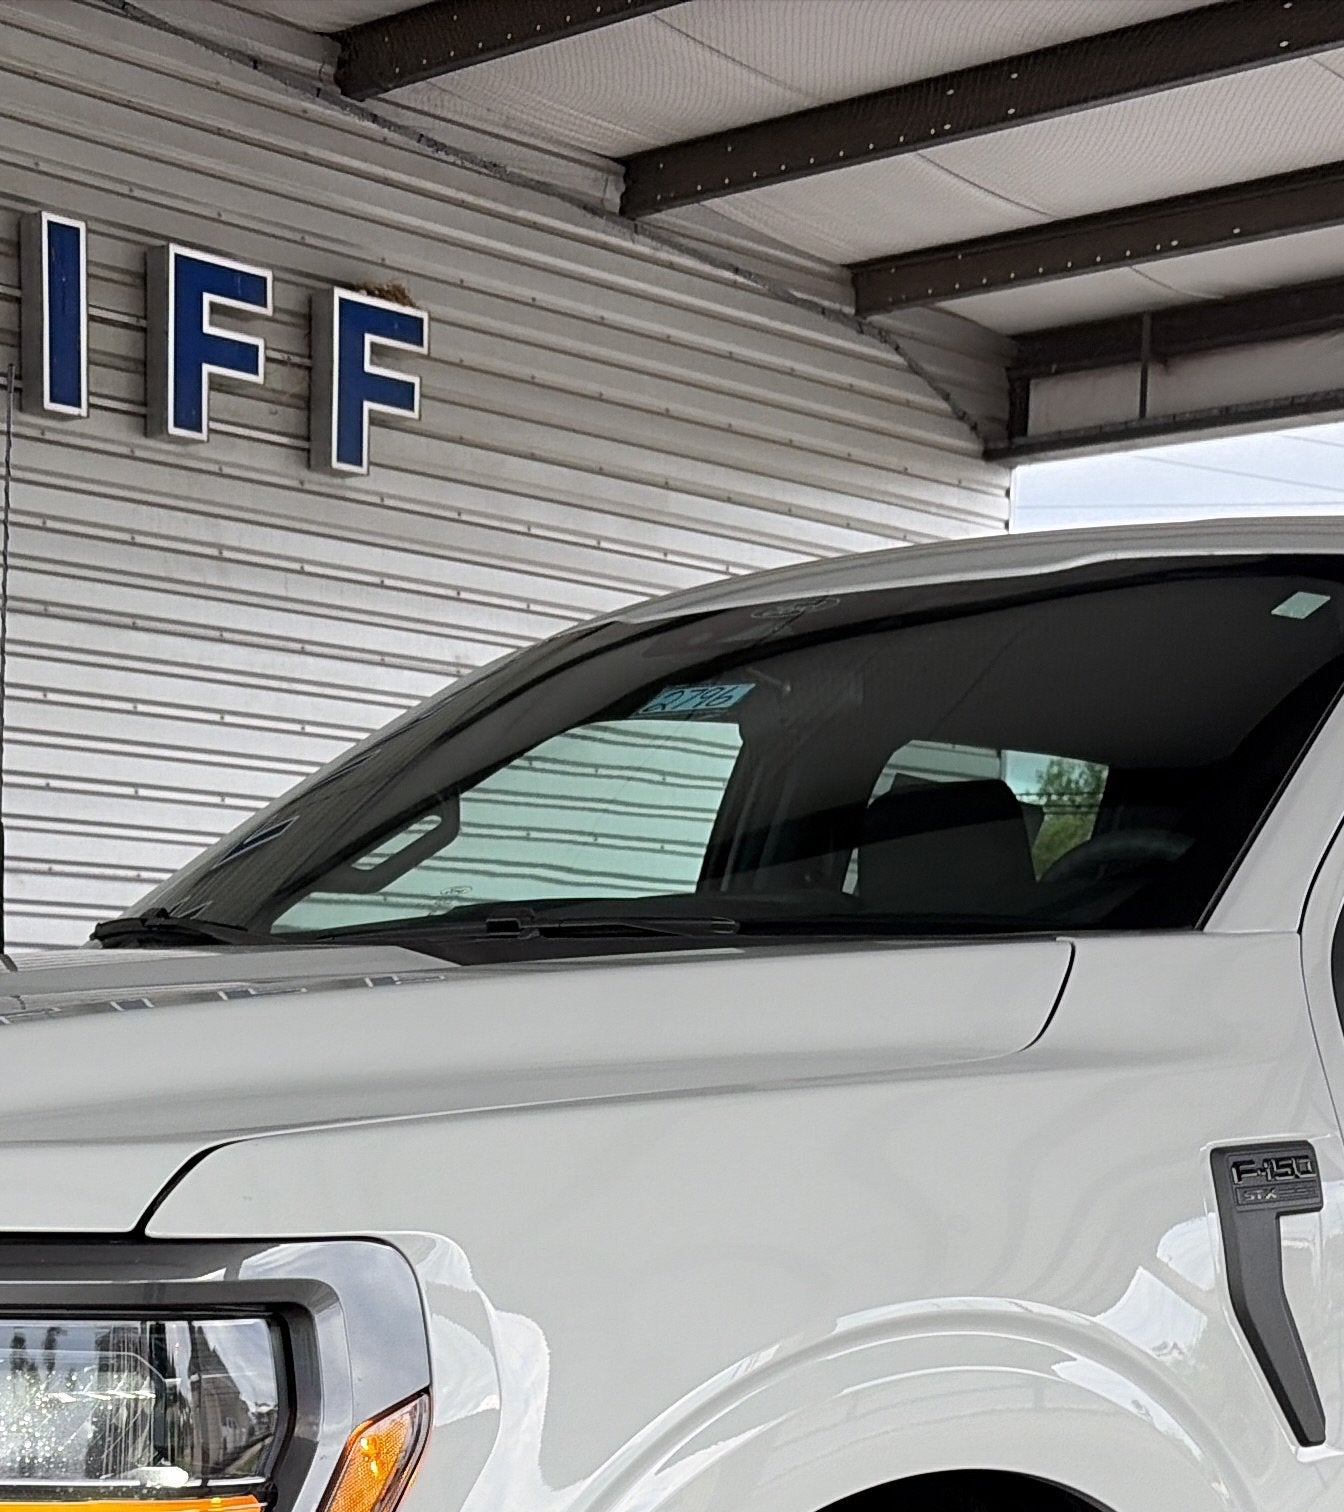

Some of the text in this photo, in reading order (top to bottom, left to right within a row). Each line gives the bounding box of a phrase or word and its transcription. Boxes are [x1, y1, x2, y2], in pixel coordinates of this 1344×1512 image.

[642, 685, 740, 713] 2796
[1231, 1155, 1318, 1185] F-150
[1243, 1187, 1278, 1201] STX
